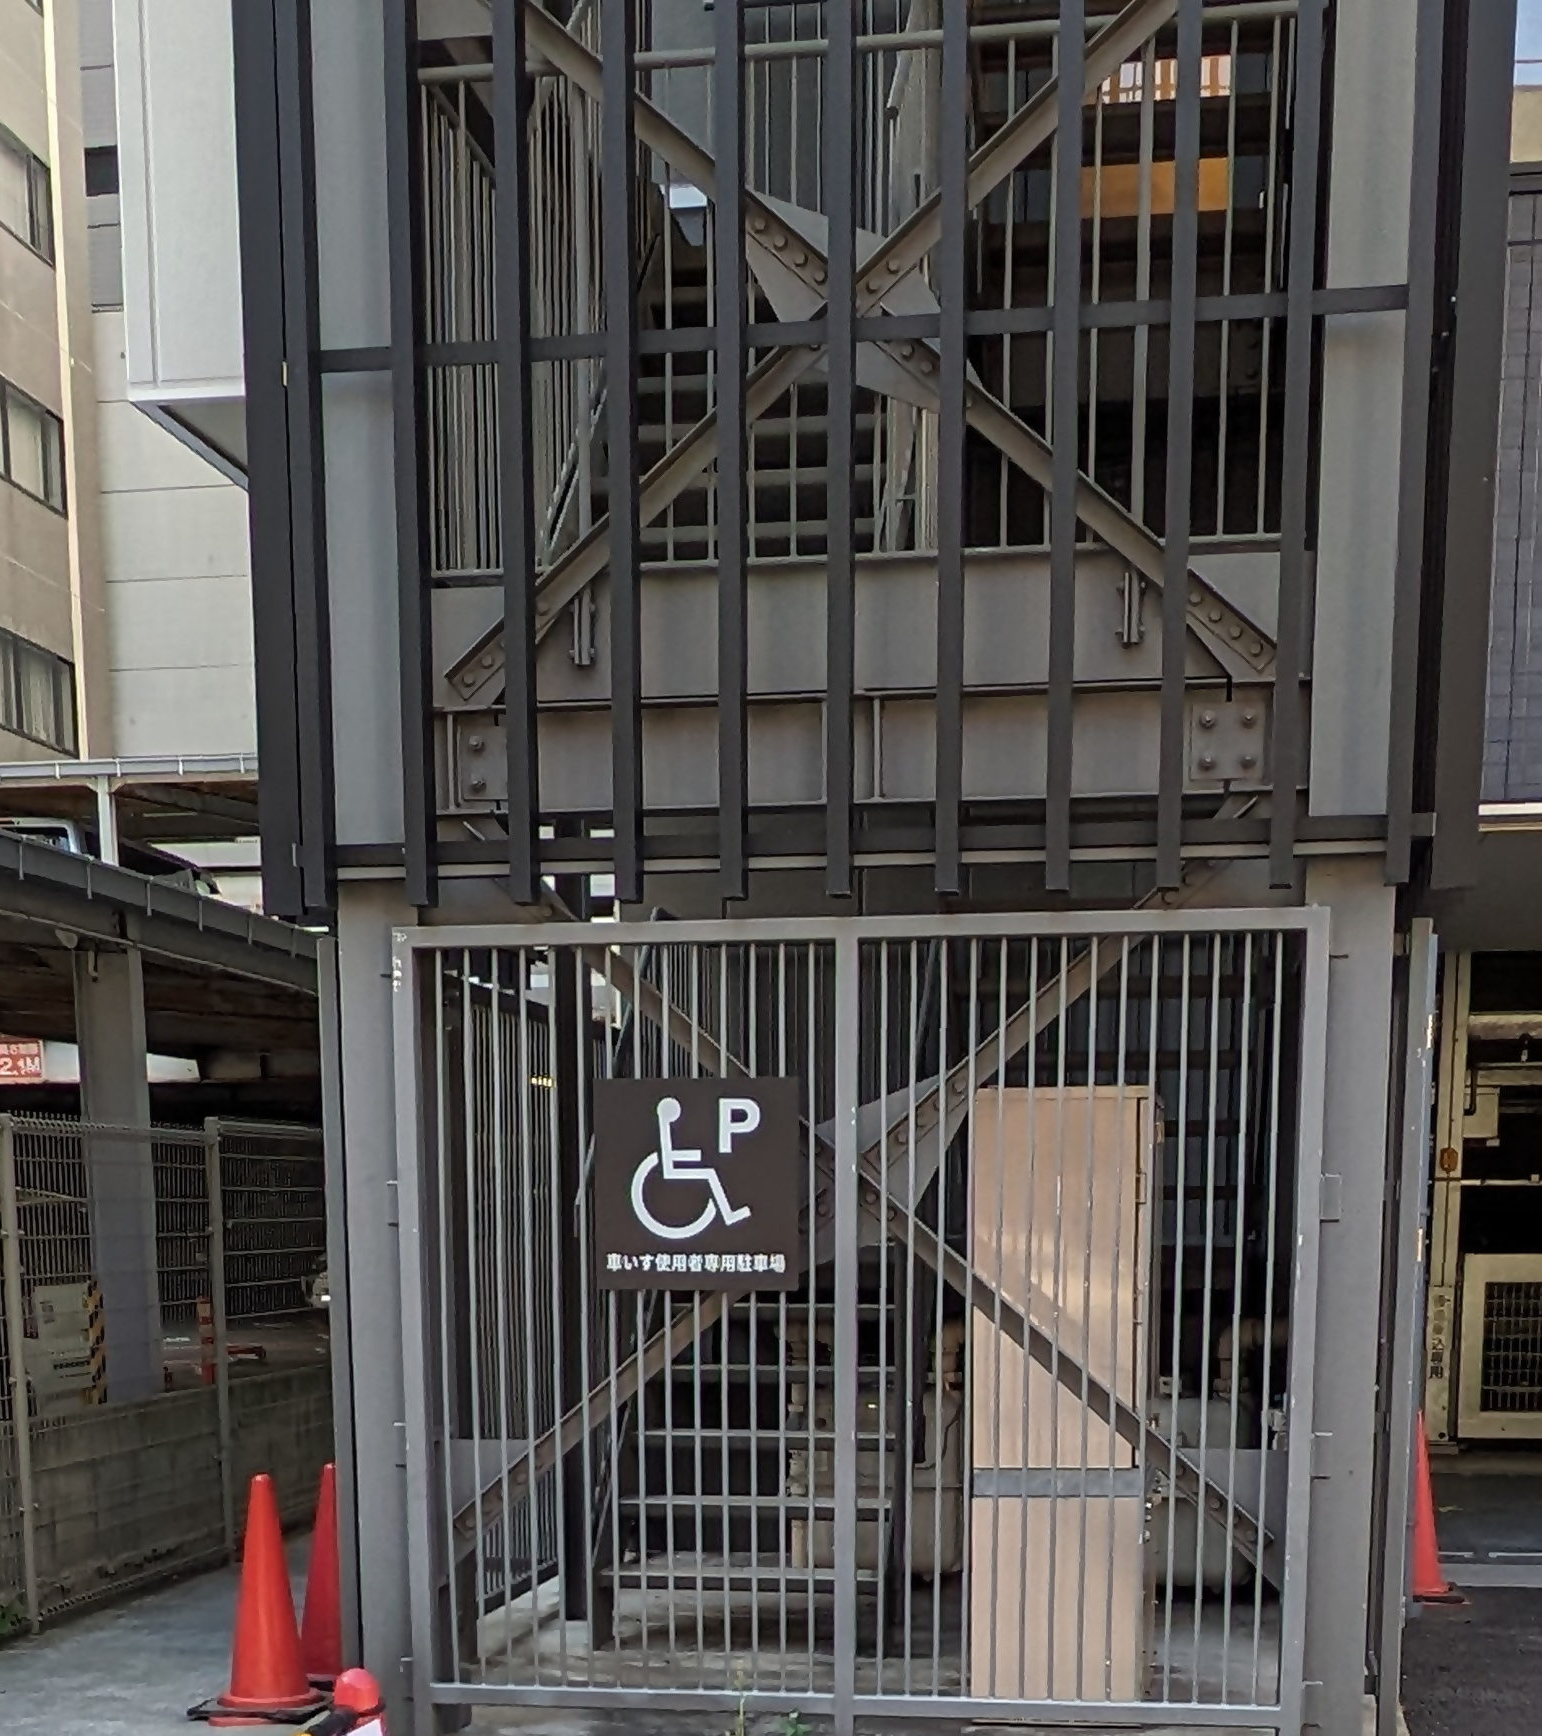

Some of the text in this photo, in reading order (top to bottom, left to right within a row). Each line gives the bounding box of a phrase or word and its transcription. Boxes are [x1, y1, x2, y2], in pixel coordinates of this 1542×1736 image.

[719, 1098, 761, 1153] P
[606, 1253, 786, 1273] 車いす使用者専用駐車場
